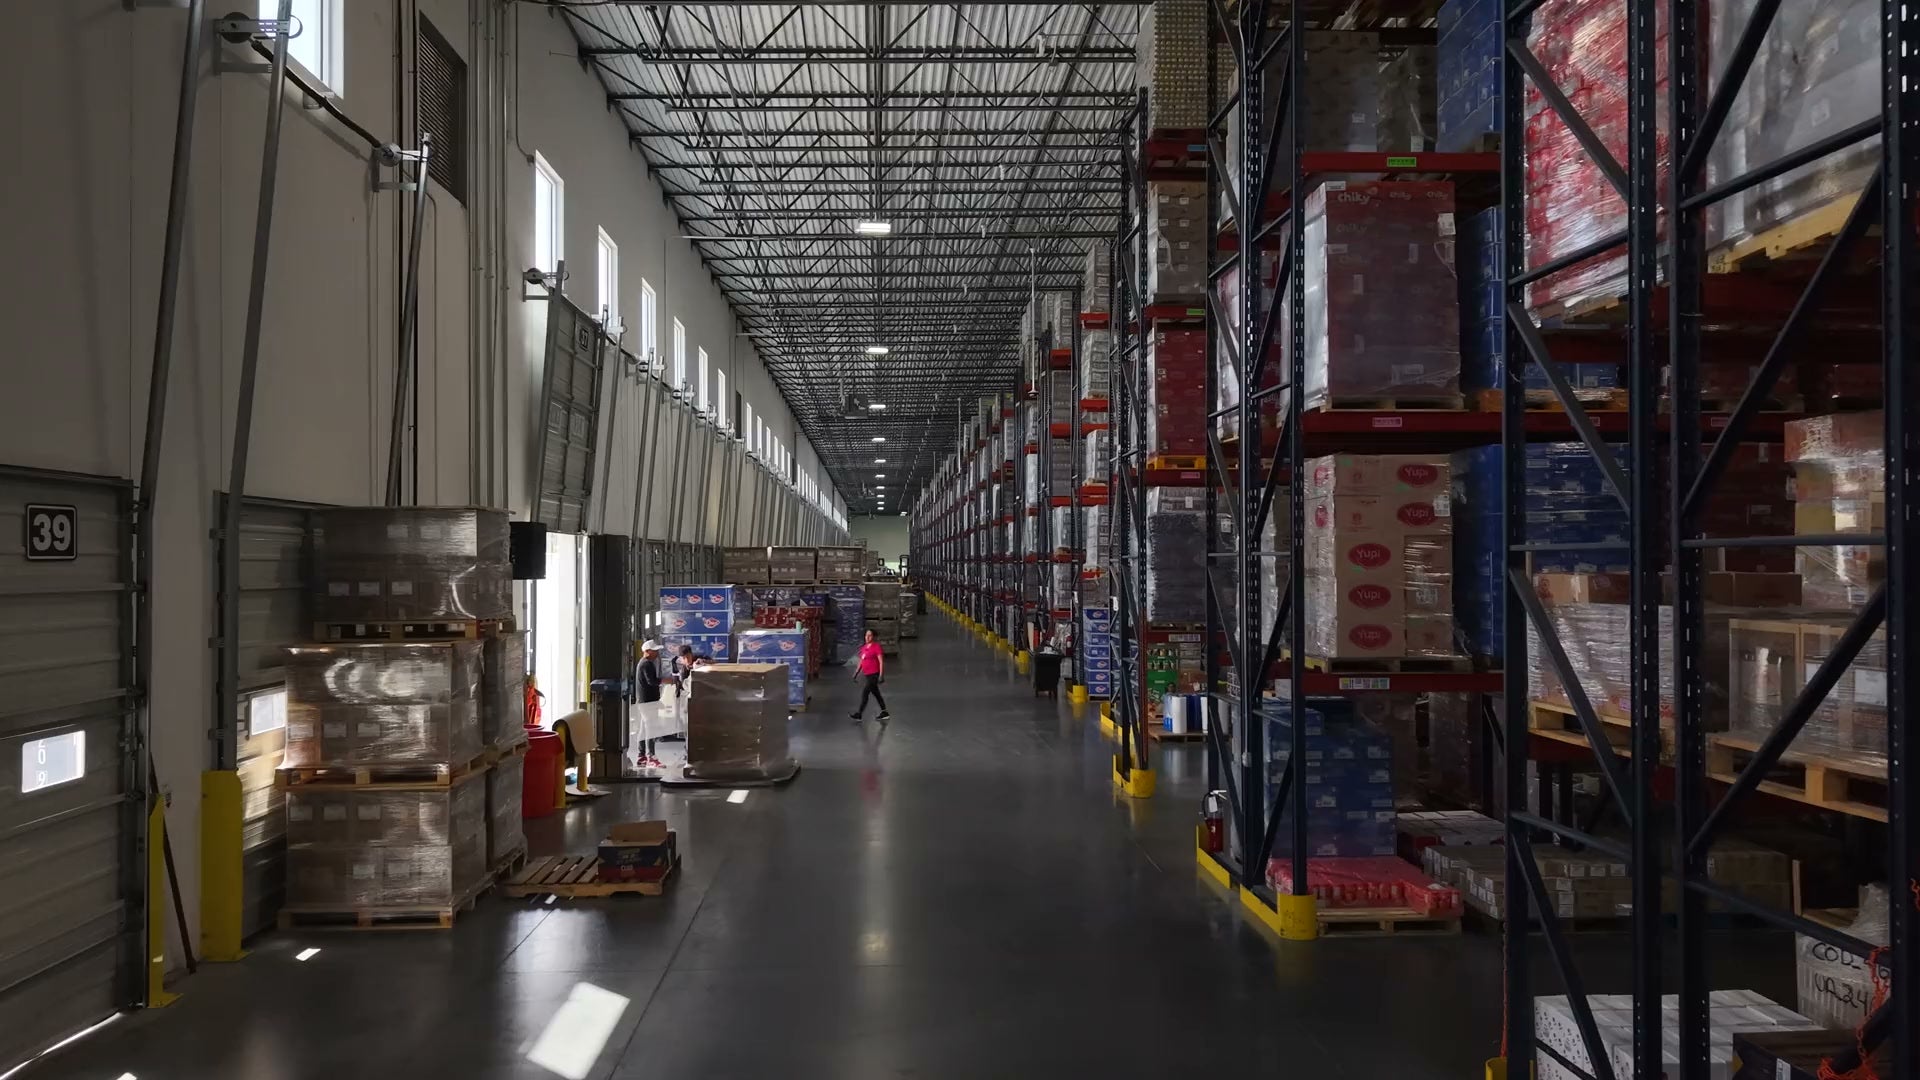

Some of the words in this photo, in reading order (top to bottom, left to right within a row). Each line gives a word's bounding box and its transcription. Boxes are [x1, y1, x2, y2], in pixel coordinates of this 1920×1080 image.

[1337, 192, 1371, 205] chiky
[1405, 466, 1430, 479] Yupi
[1405, 506, 1430, 519] Yupi
[32, 513, 72, 551] 39
[1356, 548, 1381, 560] Yupi
[1356, 589, 1381, 601] Yupi
[1357, 629, 1381, 641] Yupi
